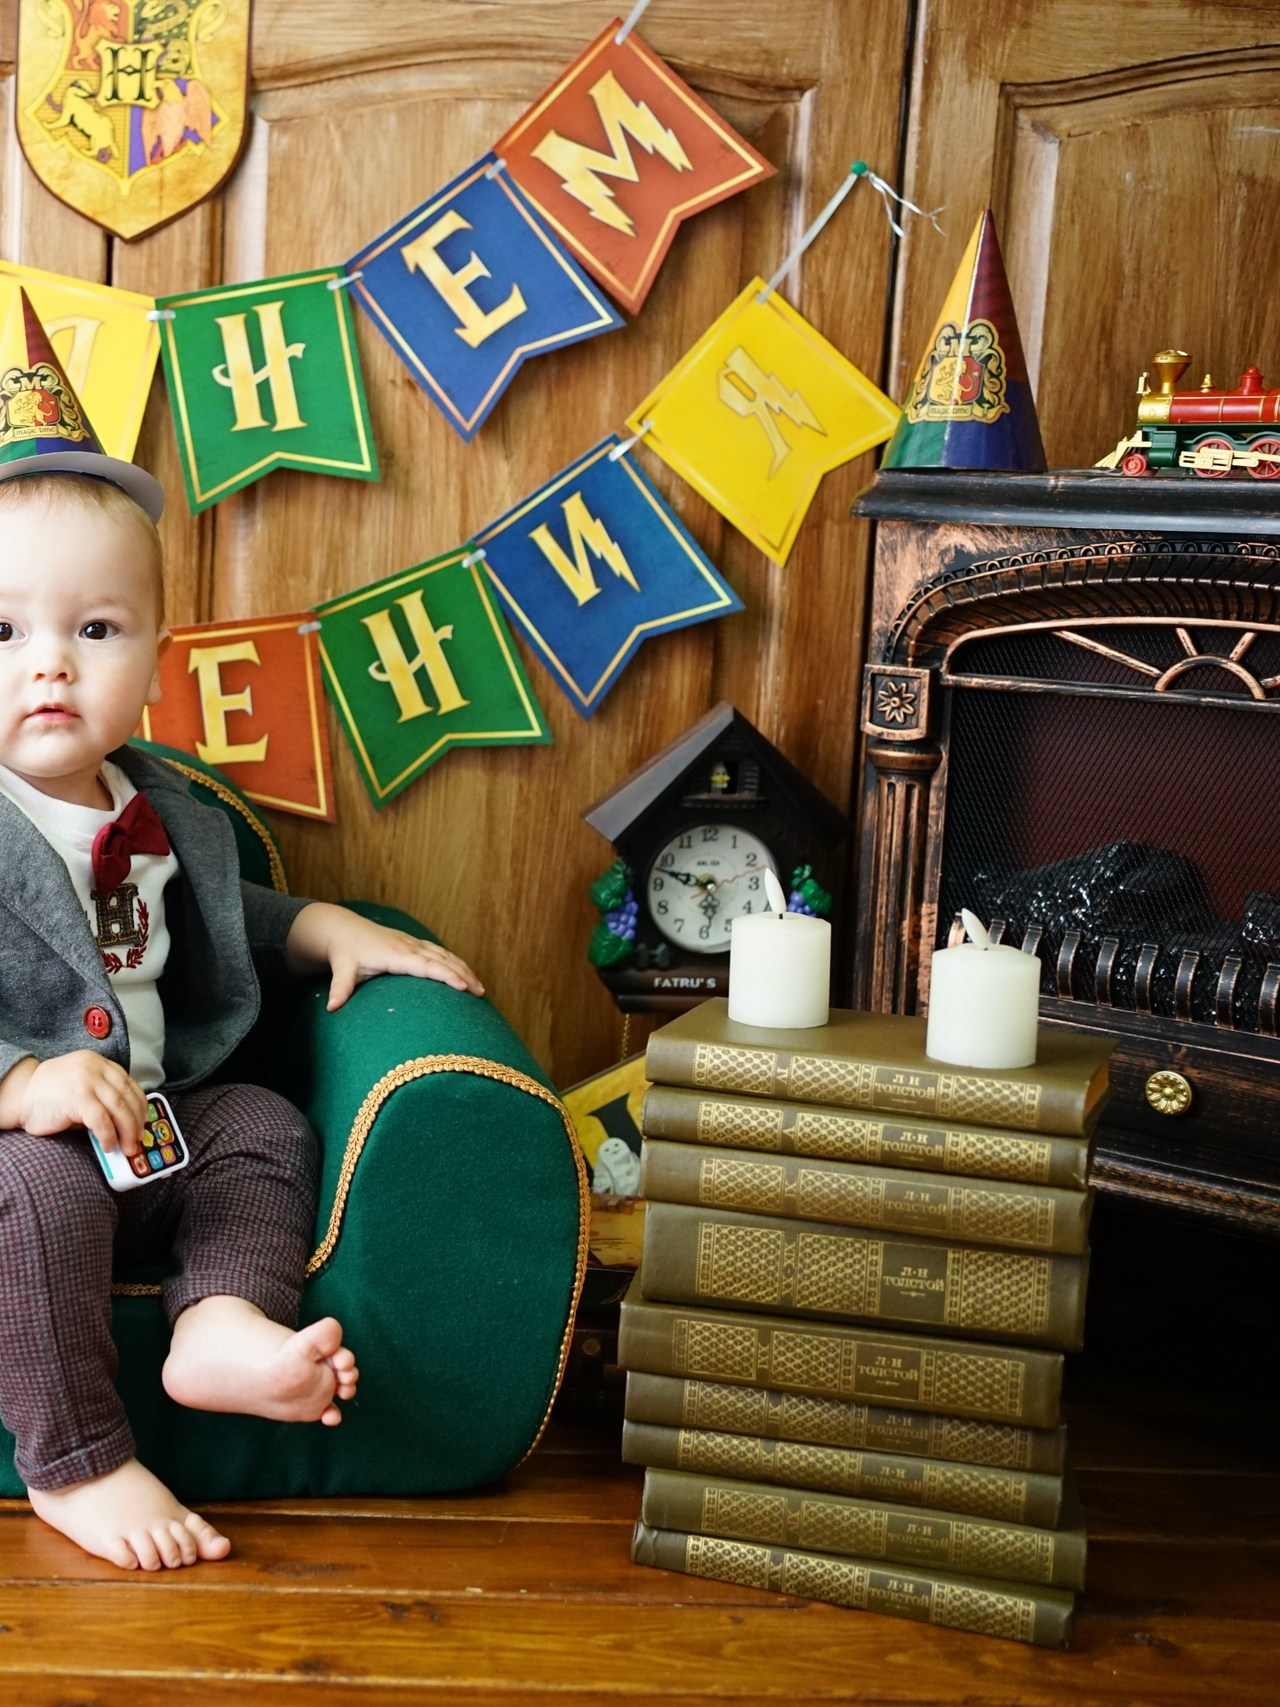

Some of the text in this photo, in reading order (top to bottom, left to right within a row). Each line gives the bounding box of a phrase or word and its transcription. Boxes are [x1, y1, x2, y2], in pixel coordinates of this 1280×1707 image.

[20, 375, 44, 391] M
[702, 828, 719, 842] 12
[731, 835, 738, 848] 1
[678, 836, 693, 849] 11
[660, 854, 675, 868] 10
[746, 854, 758, 867] 2
[653, 877, 665, 891] 9
[748, 876, 760, 890] 3
[657, 901, 669, 915] 8
[742, 900, 753, 914] 4
[674, 919, 685, 933] 7
[724, 918, 733, 932] 5
[699, 925, 710, 940] 6
[875, 1083, 935, 1099] ТОЛСТОЙ
[882, 1140, 944, 1157] ТОЛСТОЙ
[884, 1200, 947, 1215] ТОЛСТОЙ
[883, 1275, 945, 1291] ТОЛСТОЙ
[857, 1365, 919, 1381] ТОЛСТОЙ
[869, 1424, 930, 1440] ТОЛСТОЙ
[864, 1475, 922, 1491] ТОЛСТОЙ
[888, 1532, 949, 1549] ТОЛСТОЙ
[869, 1587, 931, 1607] ТОЛСТОЙ
